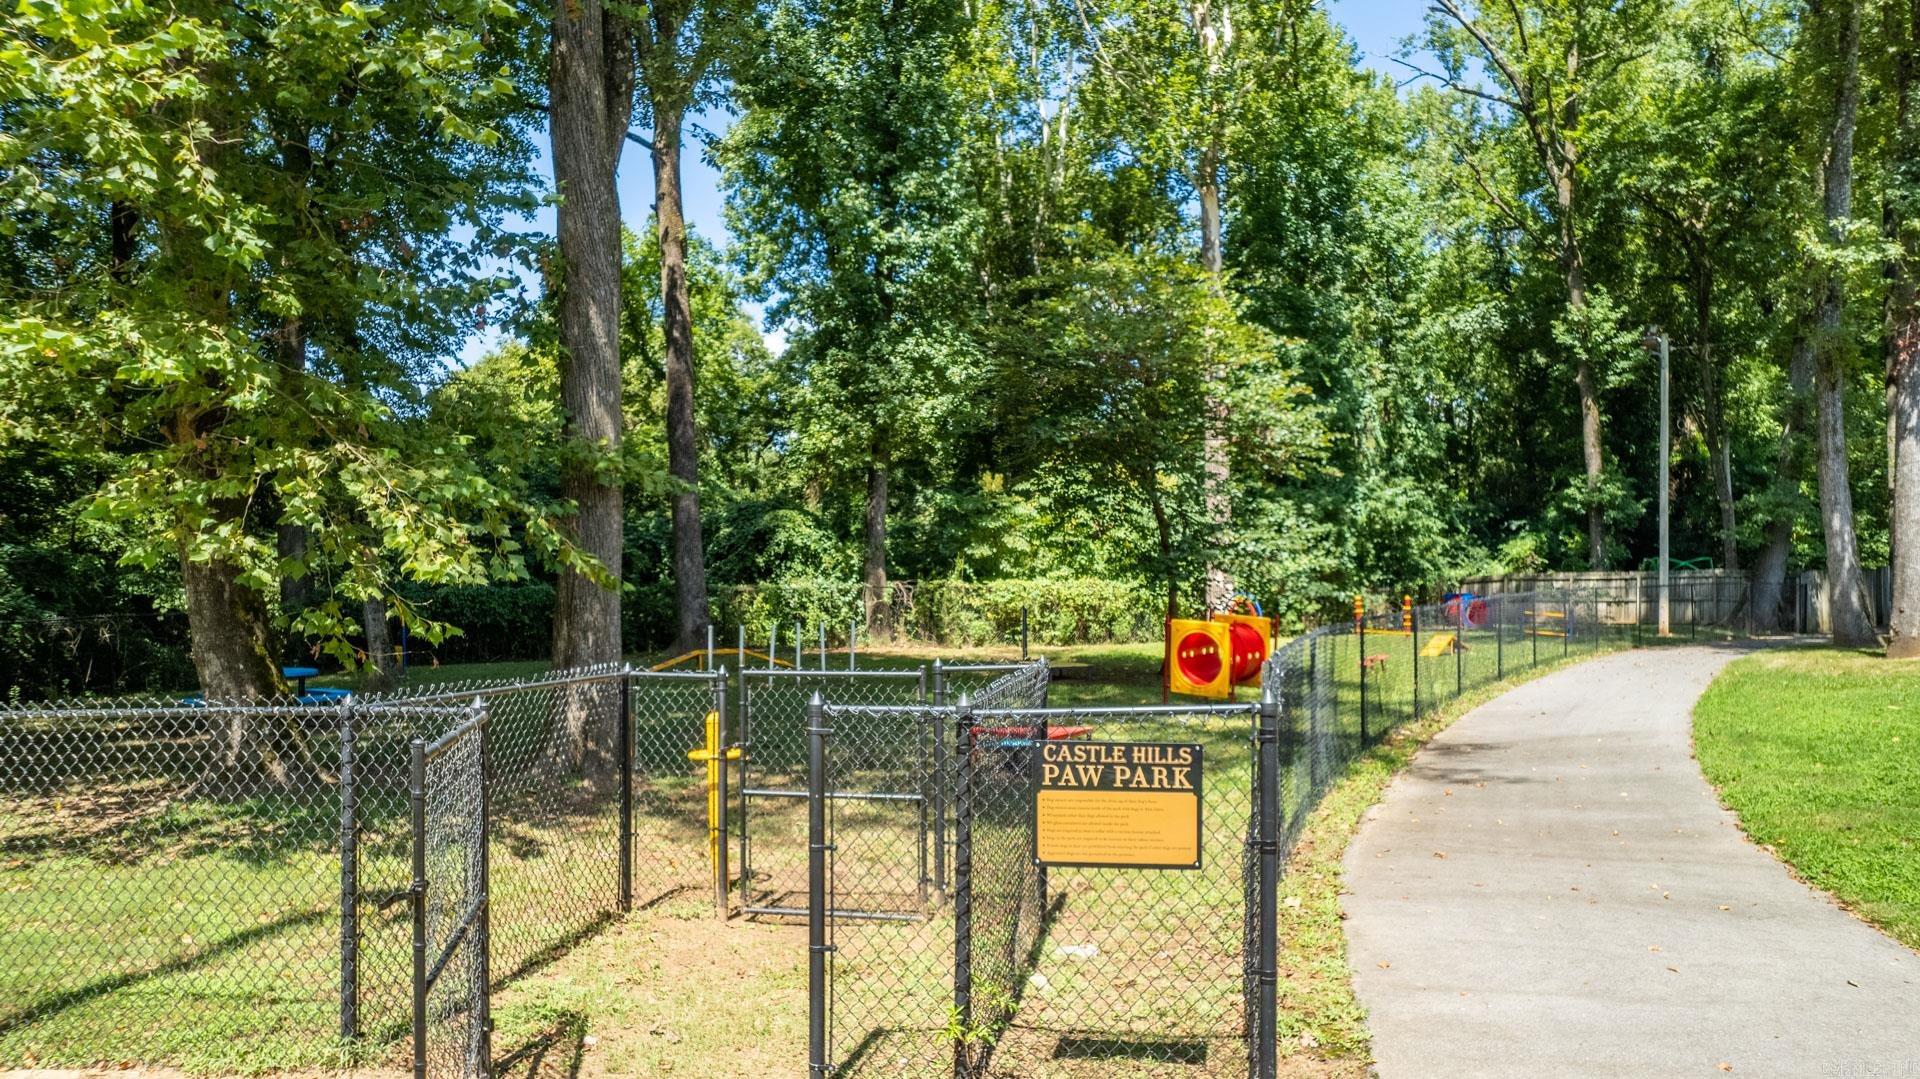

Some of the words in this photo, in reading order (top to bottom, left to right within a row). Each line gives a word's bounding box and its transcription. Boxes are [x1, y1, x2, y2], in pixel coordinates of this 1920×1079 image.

[1043, 744, 1126, 763] CASTLE
[1132, 747, 1193, 765] HILLS
[1042, 764, 1104, 787] PAW
[1113, 766, 1194, 789] PARK
